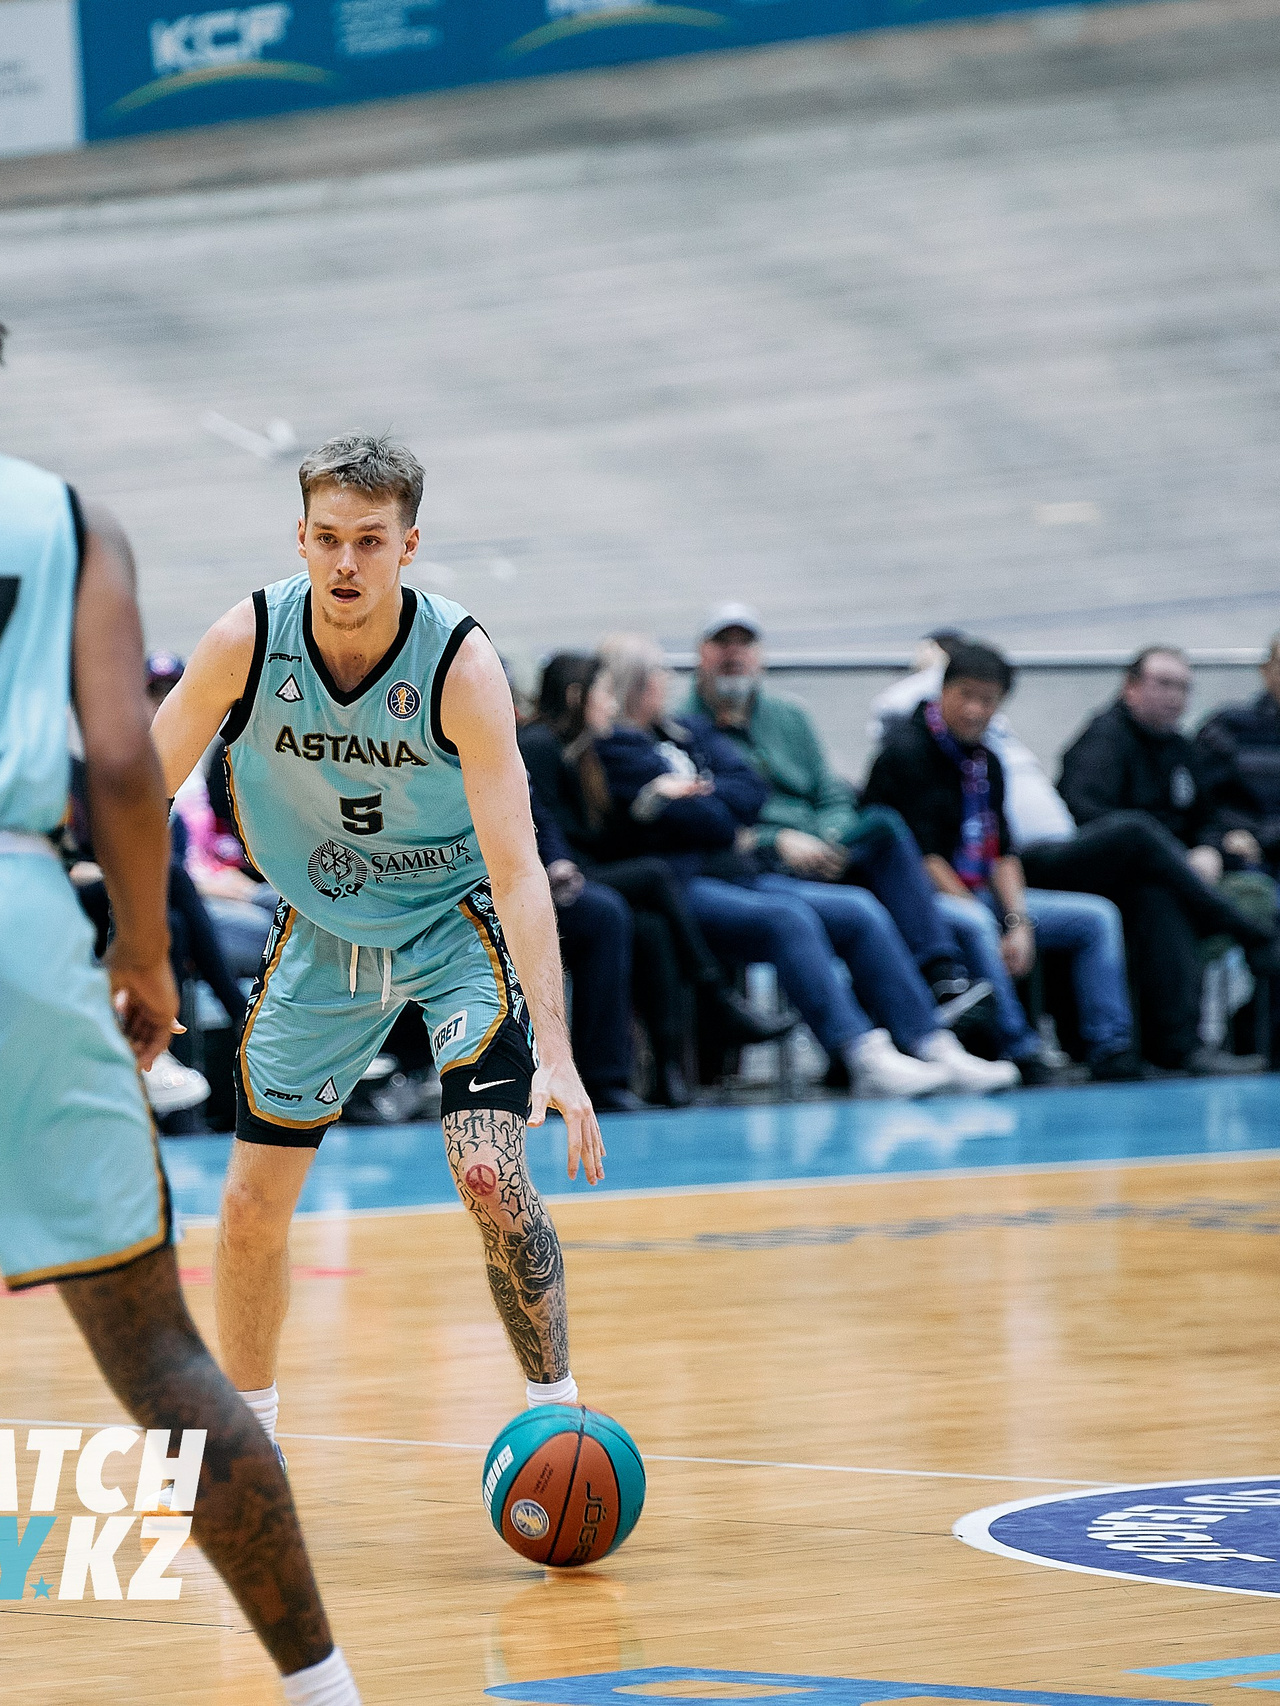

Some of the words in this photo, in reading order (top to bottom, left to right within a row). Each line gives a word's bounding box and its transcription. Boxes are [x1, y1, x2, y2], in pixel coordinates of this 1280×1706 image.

[274, 725, 429, 768] ASTANA
[339, 793, 384, 836] 5
[371, 839, 468, 873] SAMRUK
[1086, 1504, 1278, 1563] LEAGUE
